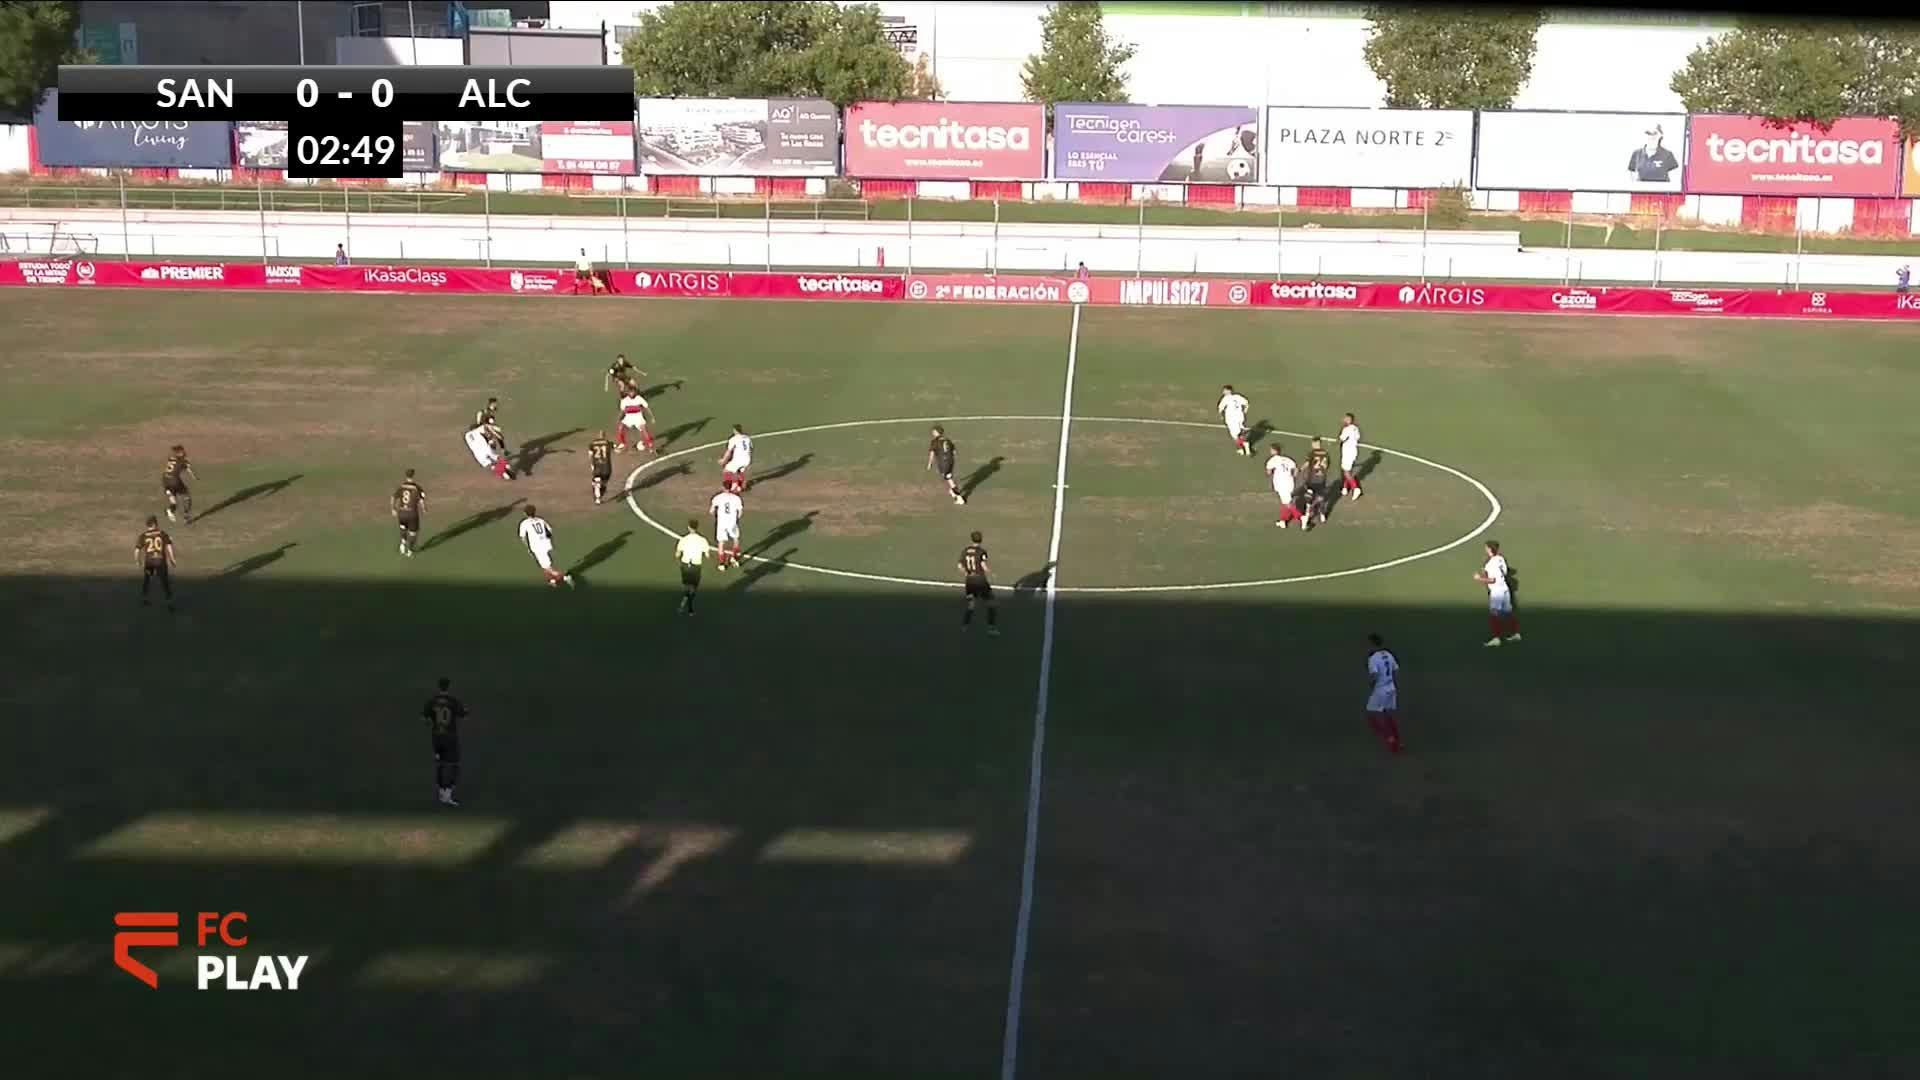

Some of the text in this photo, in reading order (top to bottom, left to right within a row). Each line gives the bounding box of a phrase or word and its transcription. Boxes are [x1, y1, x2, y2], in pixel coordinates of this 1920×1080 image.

[1065, 114, 1141, 134] Tecnigen
[859, 117, 1030, 150] tecnitasa
[1116, 130, 1177, 144] cares+
[1280, 128, 1346, 144] PLAZA
[1356, 130, 1424, 146] NORTE
[1706, 131, 1883, 164] tecnitasa
[159, 266, 225, 280] PREMIER
[364, 268, 448, 284] iKasaClass
[653, 272, 719, 290] ARGIS
[797, 274, 884, 292] tecnitasa
[953, 283, 1059, 300] FEDERACIÓN
[1270, 282, 1357, 299] tecnitasa
[1119, 280, 1210, 305] IMPULSO27
[1416, 286, 1485, 305] ARGIS
[145, 536, 163, 553] 20
